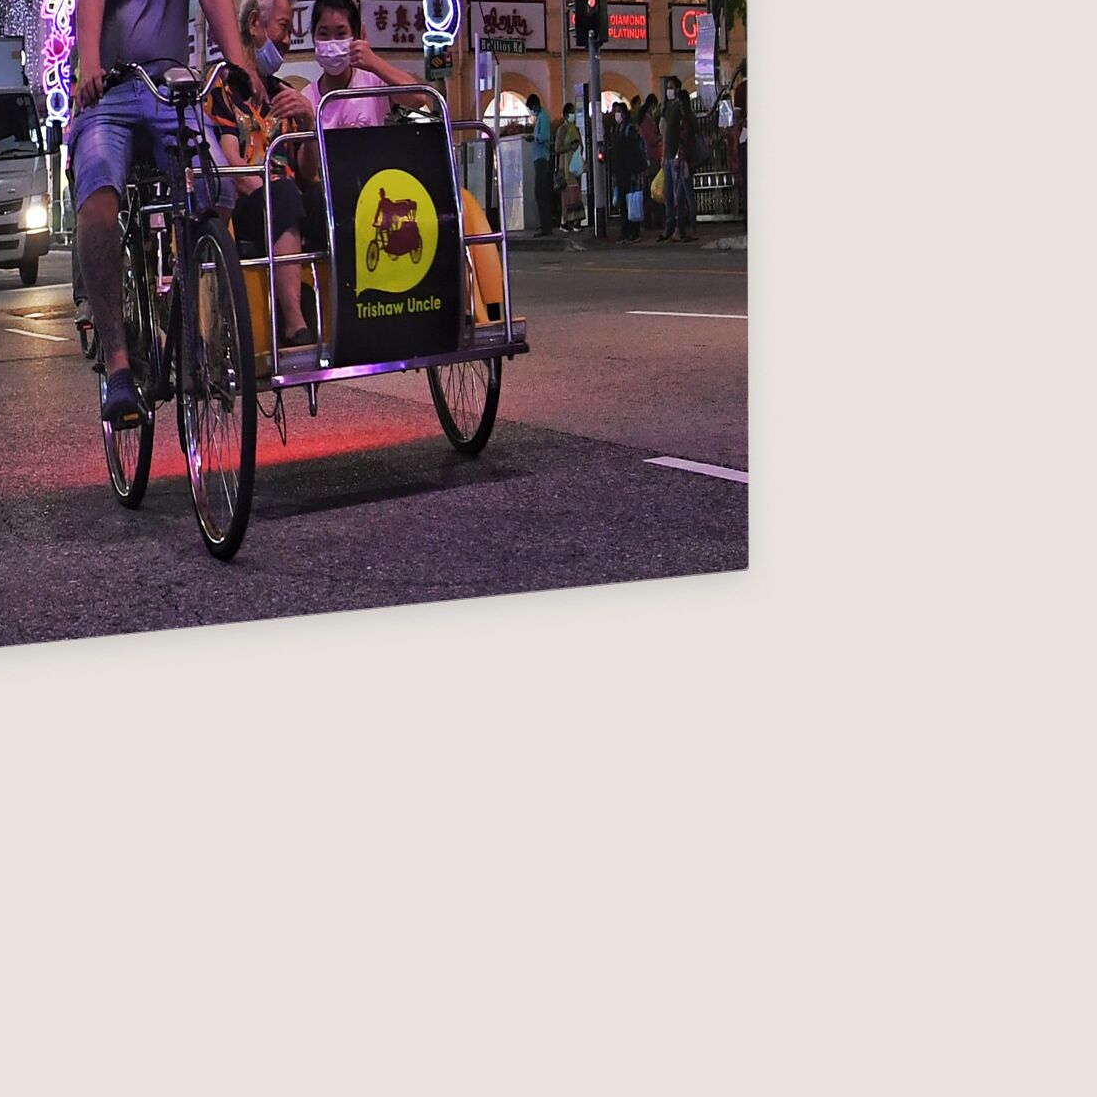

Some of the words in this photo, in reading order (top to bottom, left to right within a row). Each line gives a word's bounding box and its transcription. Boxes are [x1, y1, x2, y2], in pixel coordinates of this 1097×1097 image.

[609, 13, 646, 26] DIAMOND
[607, 28, 647, 40] PLATINUM
[513, 41, 523, 53] Rd
[356, 301, 404, 319] Trishaw
[407, 295, 441, 313] Uncle
